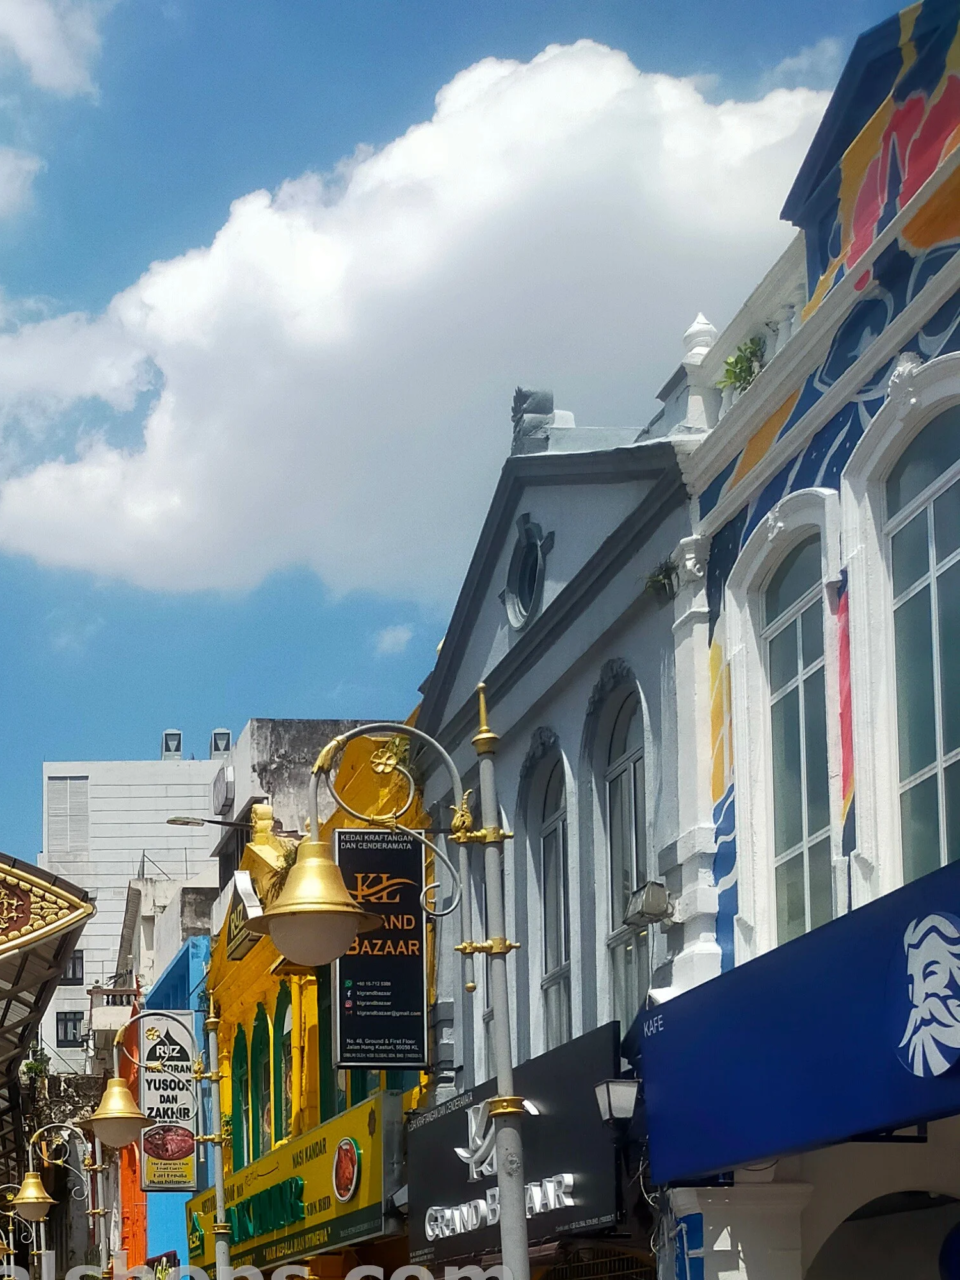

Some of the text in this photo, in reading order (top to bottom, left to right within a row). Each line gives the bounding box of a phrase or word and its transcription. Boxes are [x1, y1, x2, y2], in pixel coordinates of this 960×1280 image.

[340, 834, 414, 842] KEDAI KRAFTANGAN
[340, 842, 412, 850] DAN CENDERAMATA
[351, 873, 406, 903] KL
[345, 936, 420, 956] BAZAAR
[643, 1013, 664, 1038] KAFE
[145, 1078, 192, 1092] YUSOOF
[159, 1094, 178, 1104] DAN
[147, 1106, 191, 1120] ZAKHIR
[292, 1137, 327, 1170] NASI KANDAR
[213, 1175, 305, 1248] AKHIR
[425, 1173, 575, 1242] GRAND BAAR
